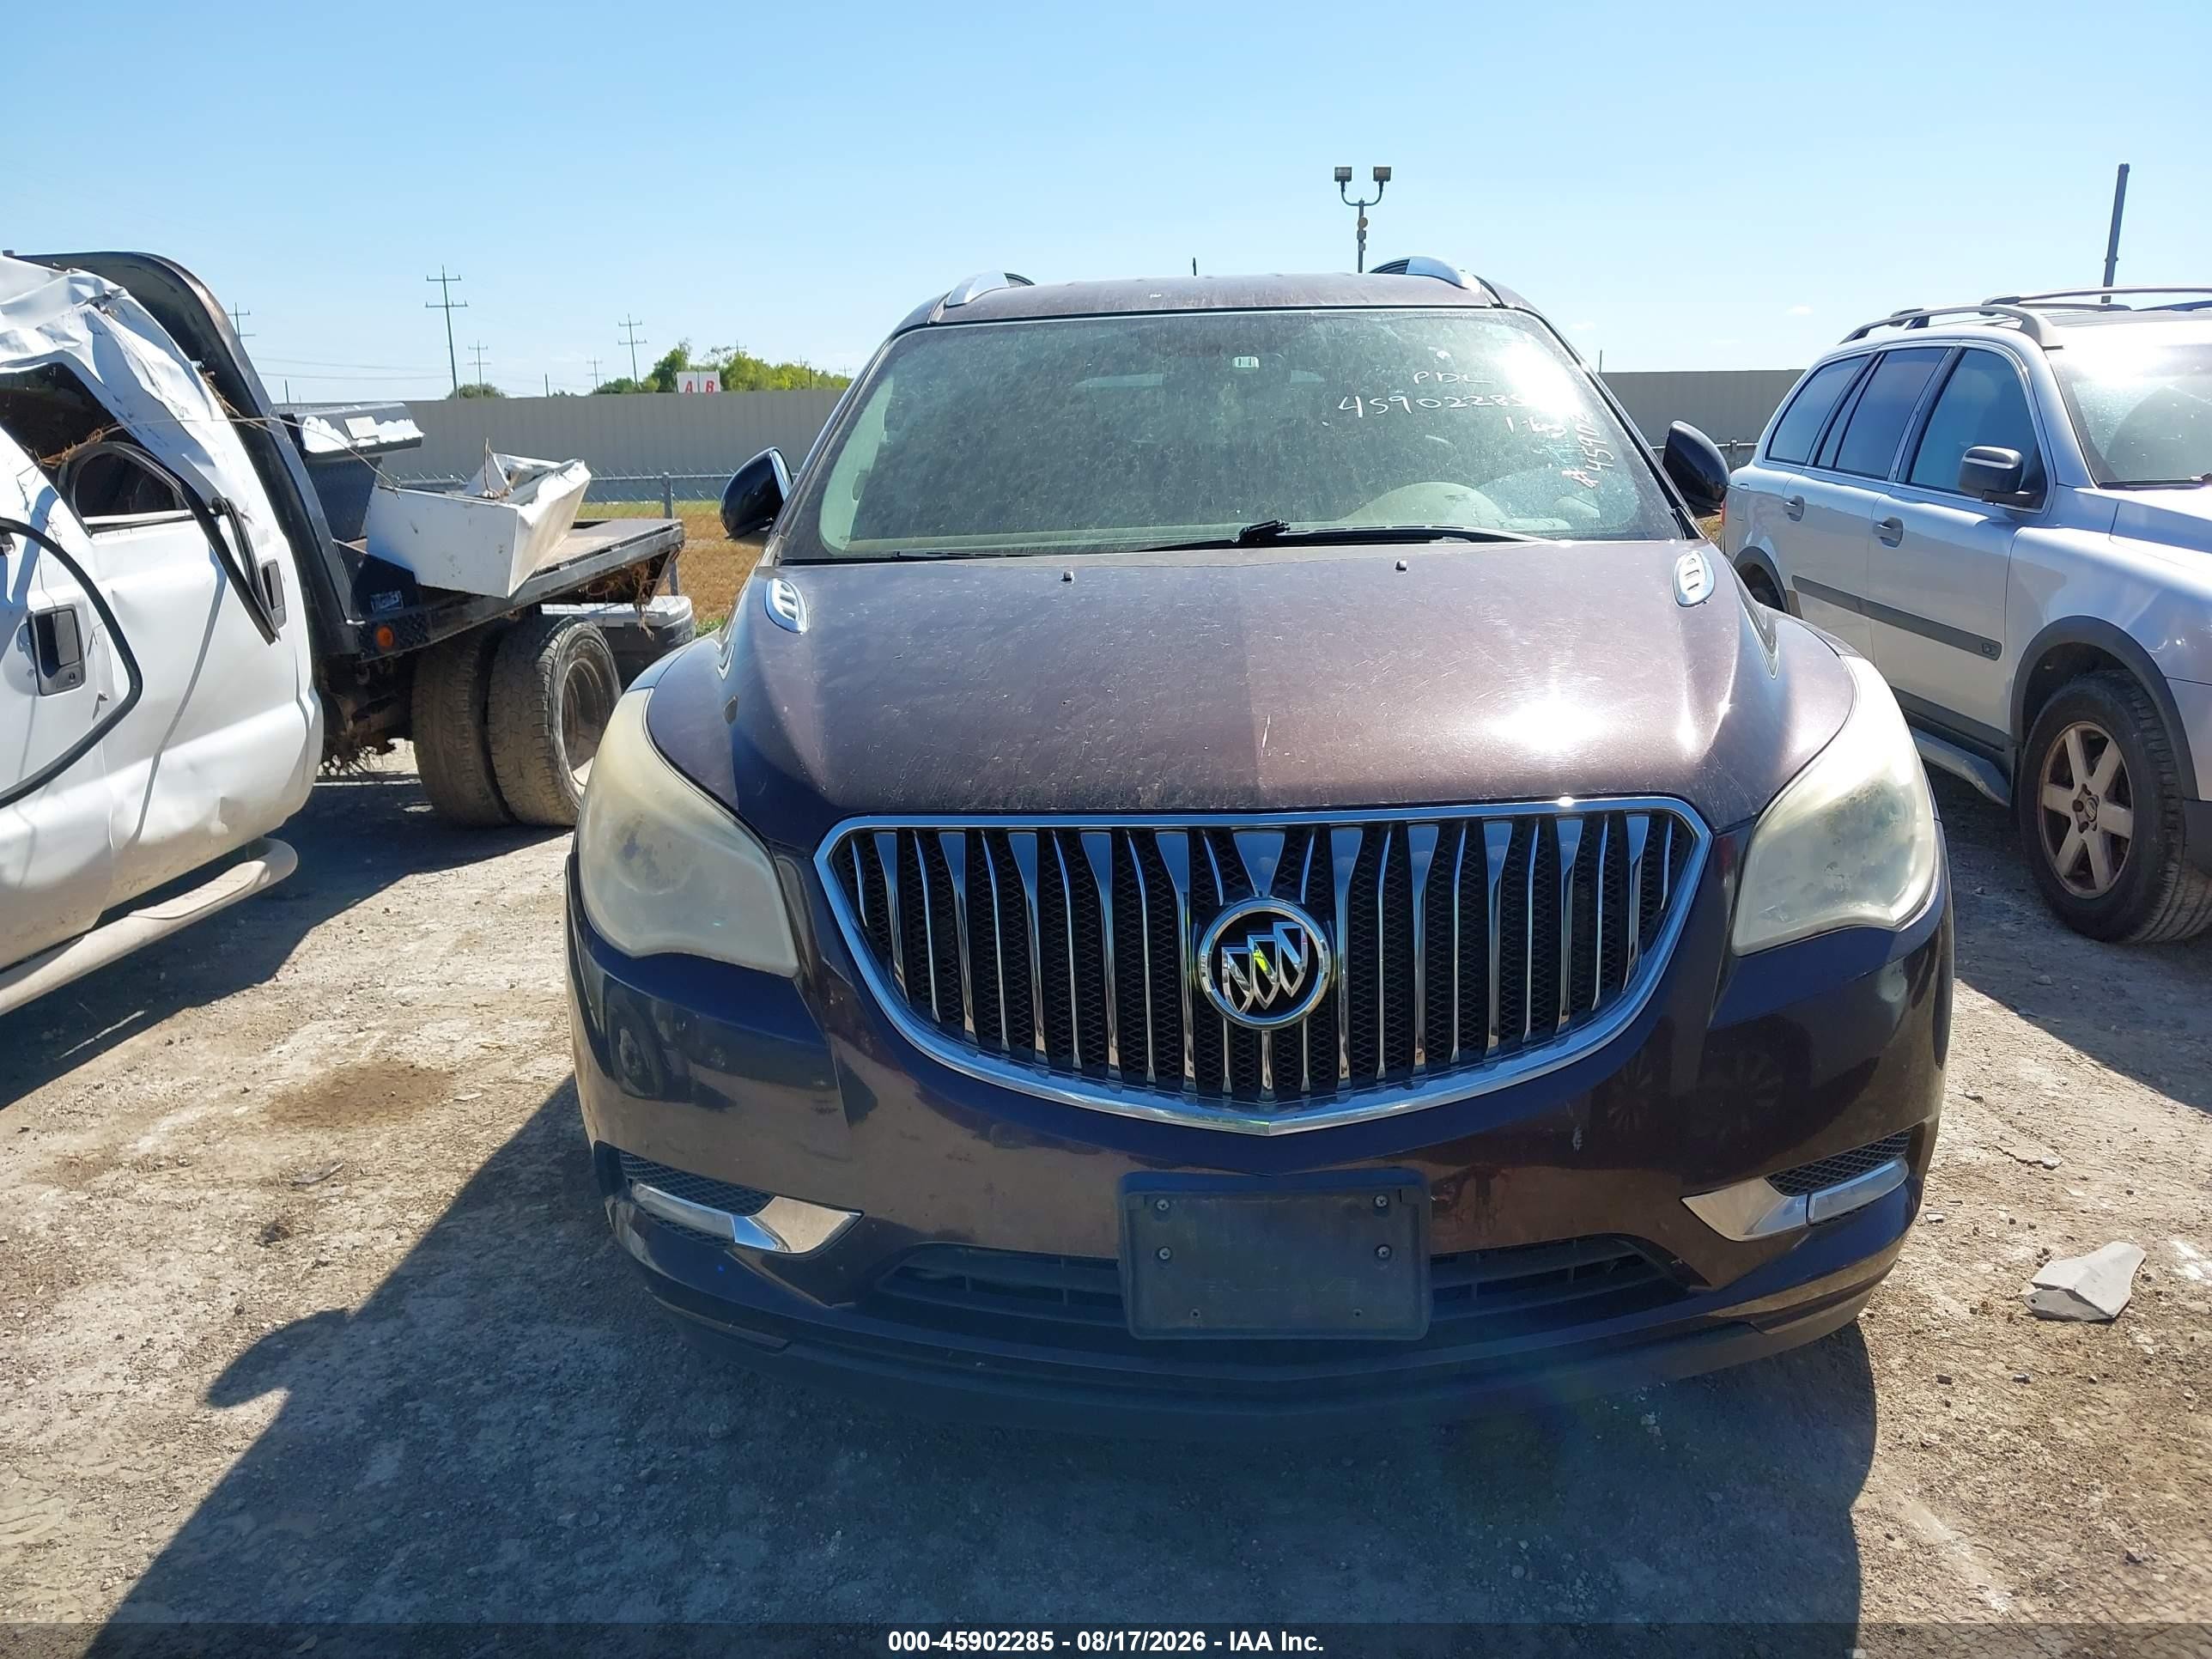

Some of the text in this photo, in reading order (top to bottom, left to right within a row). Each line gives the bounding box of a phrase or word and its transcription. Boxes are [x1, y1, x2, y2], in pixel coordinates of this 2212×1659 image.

[1413, 370, 1492, 385] PDL
[685, 380, 693, 393] A
[707, 380, 715, 392] B
[1337, 393, 1528, 419] 45902285
